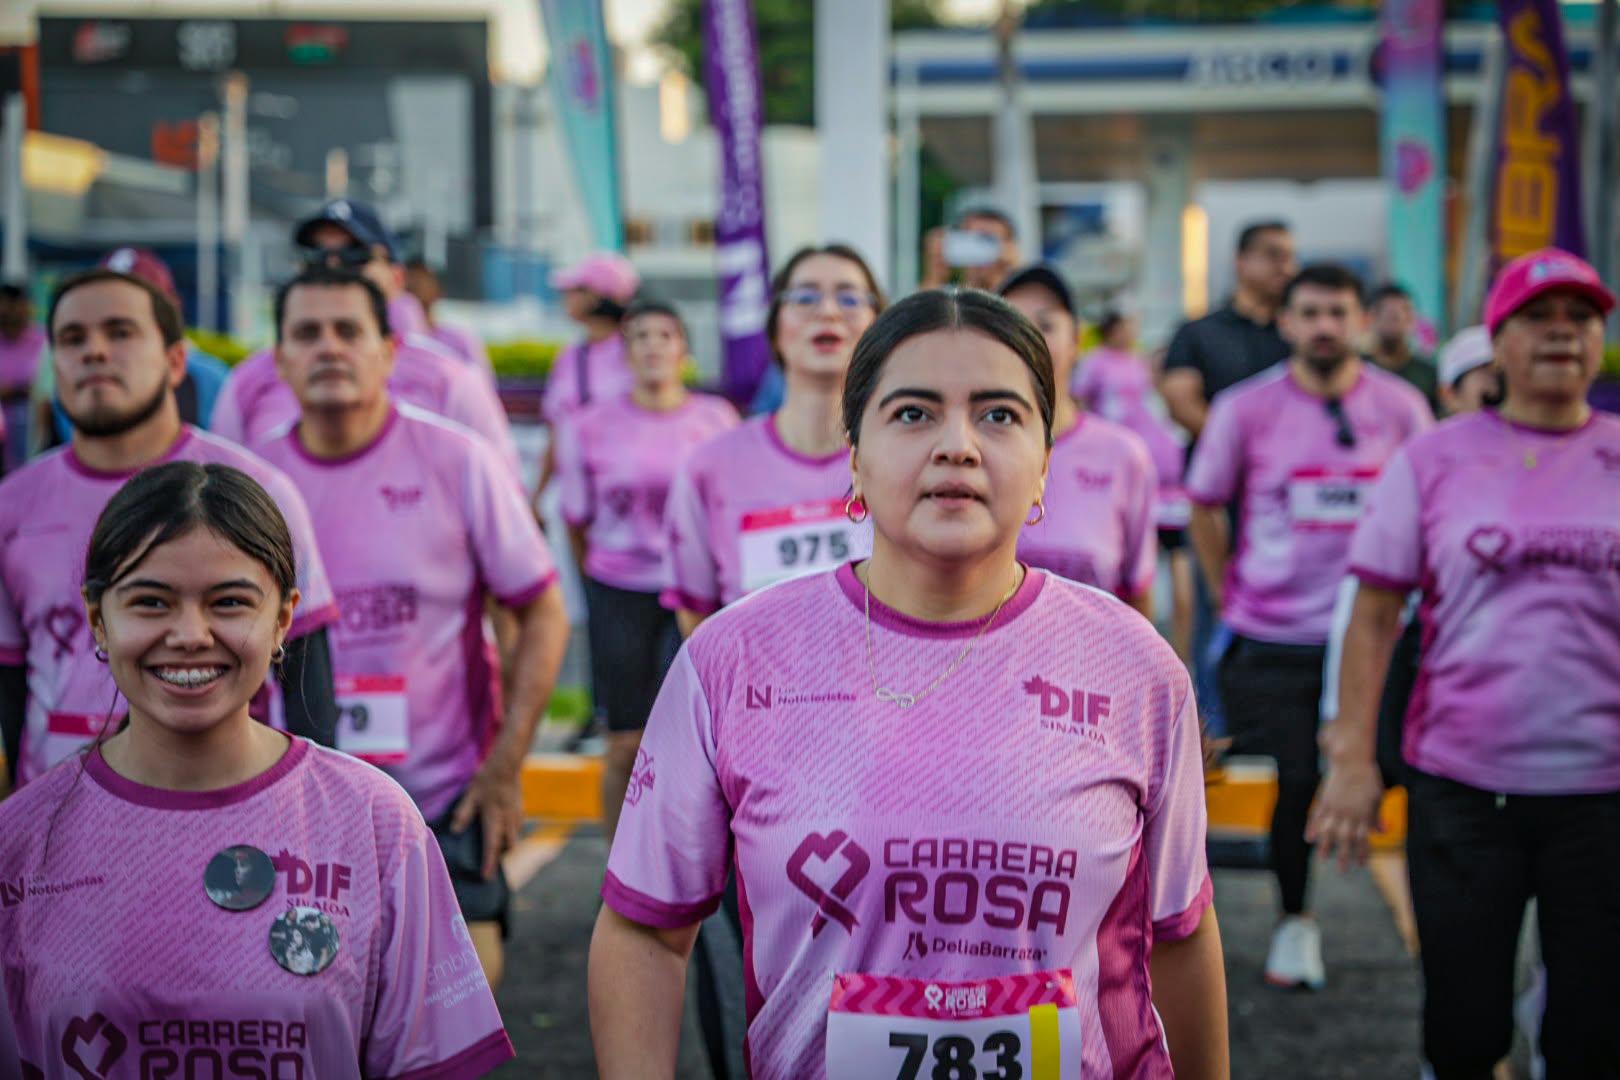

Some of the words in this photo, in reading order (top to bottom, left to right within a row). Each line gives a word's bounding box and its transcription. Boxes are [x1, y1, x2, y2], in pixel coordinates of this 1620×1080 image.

[779, 531, 849, 566] 975
[1039, 681, 1111, 728] DIF
[1040, 719, 1105, 745] SINALOA
[286, 855, 352, 902] DIF
[883, 837, 1078, 880] CARRERA
[883, 870, 1071, 937] ROSA
[138, 1020, 306, 1048] CARRERA
[889, 1030, 1023, 1080] 783
